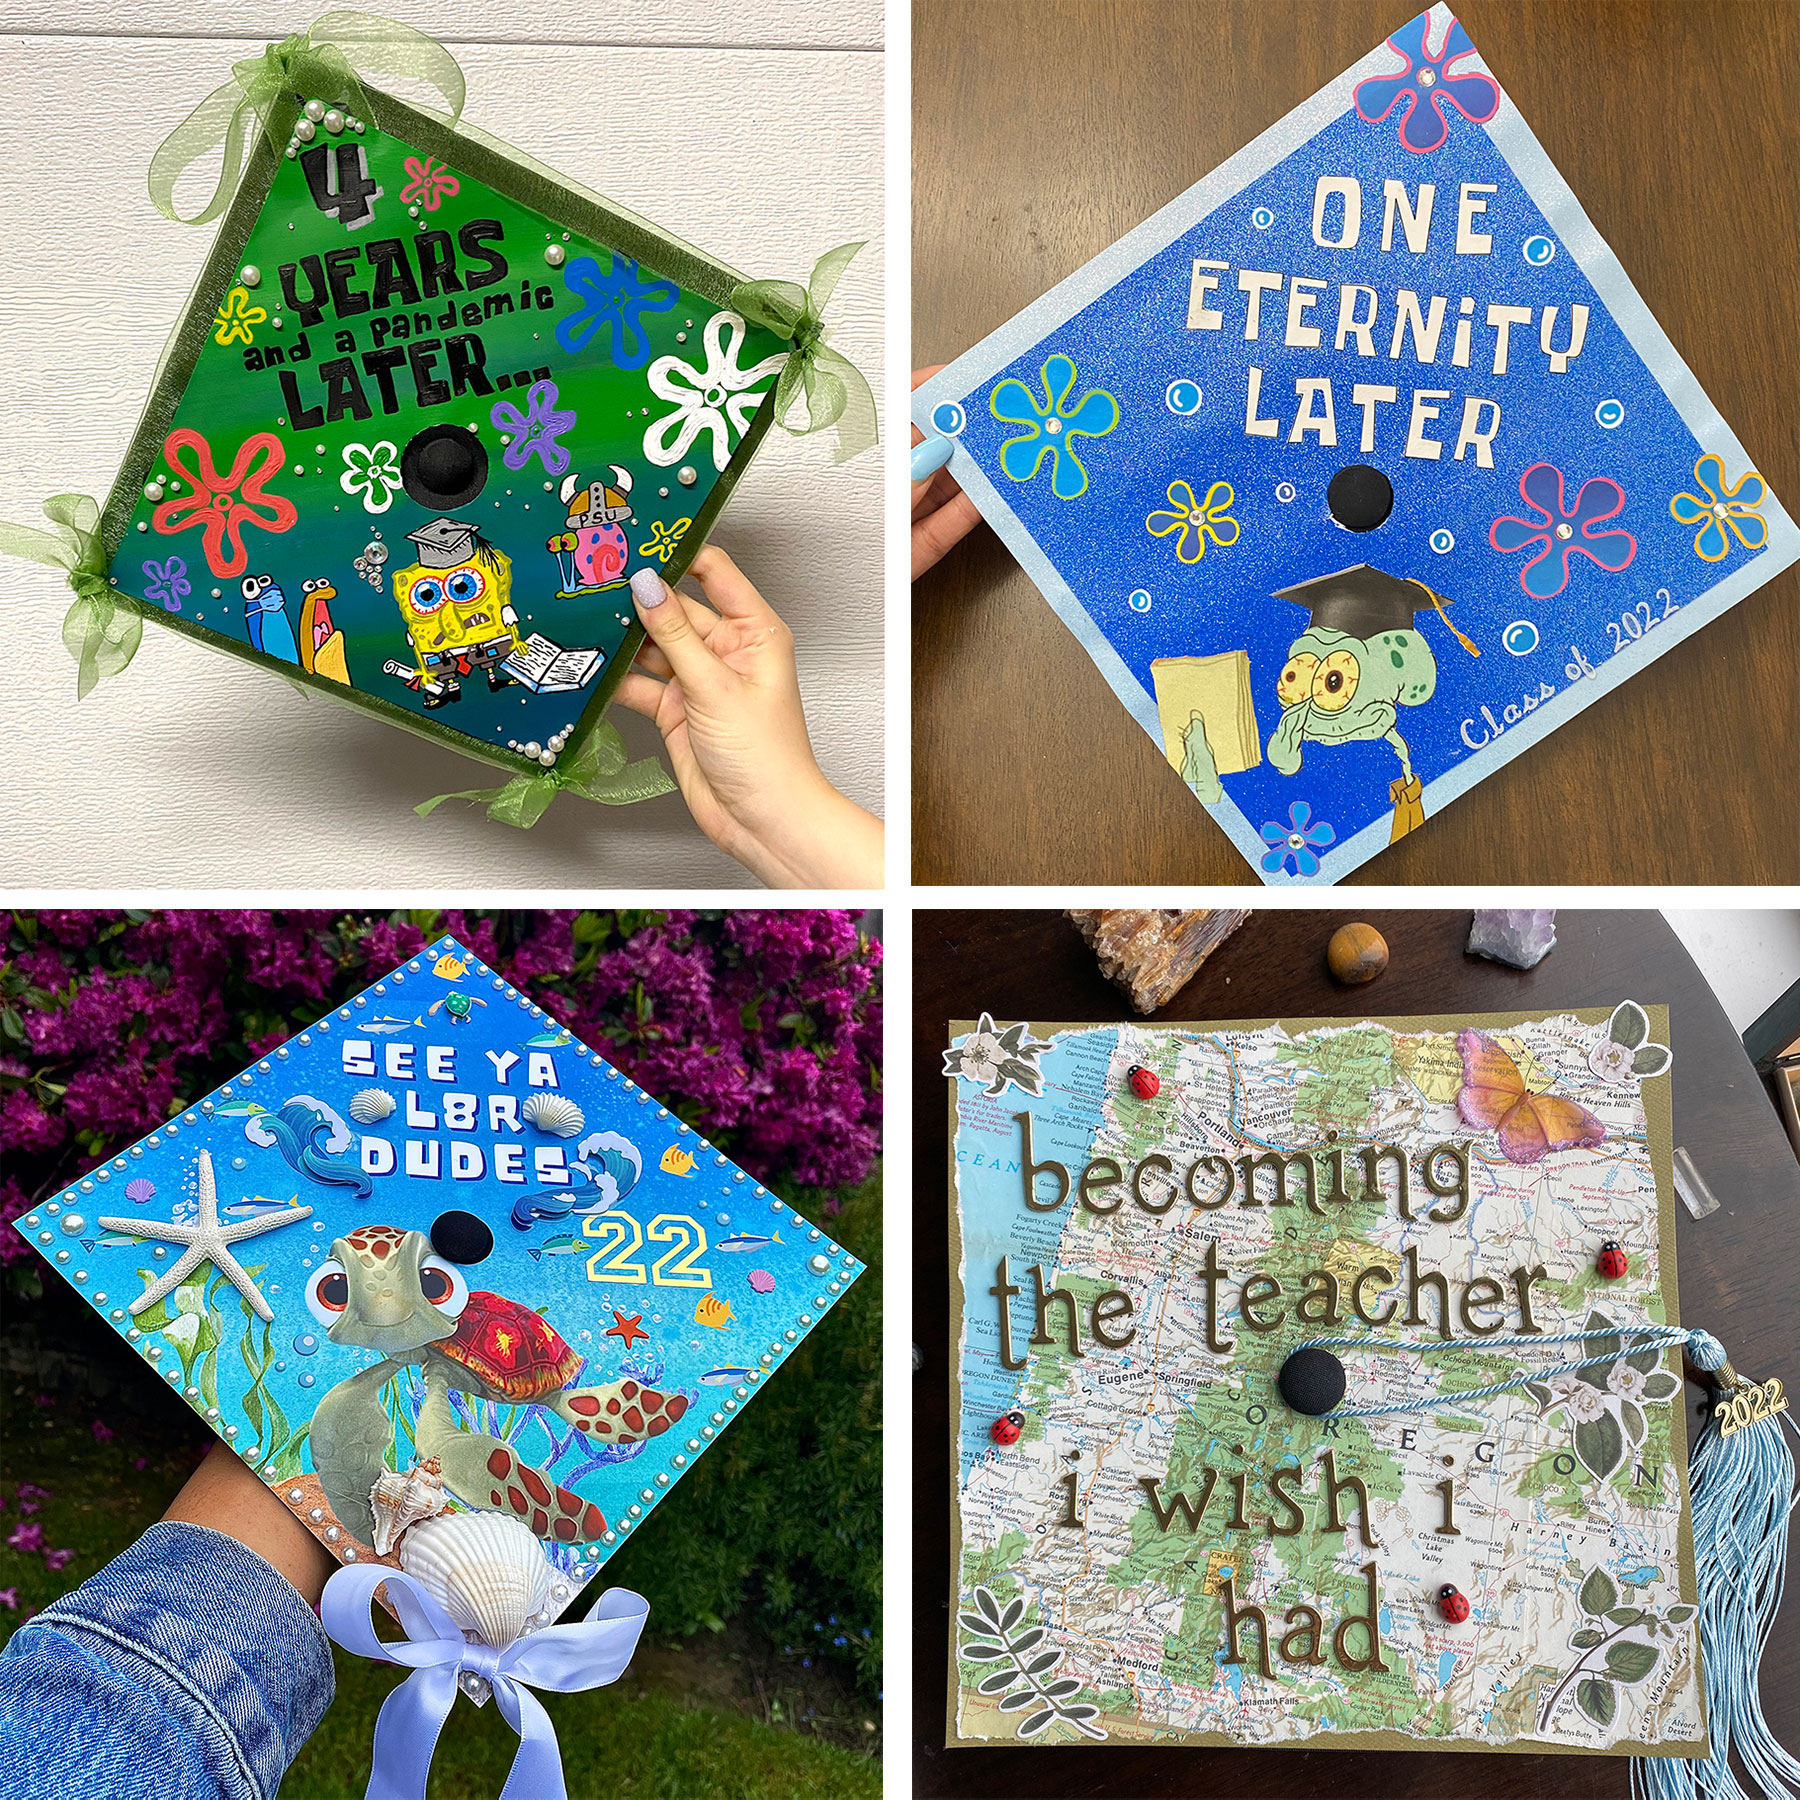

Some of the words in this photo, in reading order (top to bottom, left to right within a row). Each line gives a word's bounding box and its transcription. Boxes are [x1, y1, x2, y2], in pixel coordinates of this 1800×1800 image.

[299, 142, 384, 231] 4
[1312, 176, 1498, 255] ONE
[278, 219, 508, 328] YEARS
[243, 332, 312, 372] and
[335, 330, 356, 354] a
[370, 280, 554, 348] pandemic
[279, 334, 552, 431] LATER...
[1245, 367, 1501, 469] LATER
[579, 510, 617, 527] PSU
[1460, 682, 1555, 750] Class
[1565, 646, 1597, 680] of
[1606, 588, 1680, 653] 2022
[1235, 1042, 1257, 1052] Kelso
[1538, 1049, 1568, 1058] Granger
[342, 1040, 457, 1082] SEE
[485, 1049, 559, 1087] YA
[1417, 1055, 1445, 1067] Yakima
[1264, 1102, 1284, 1110] Battle
[1284, 1100, 1311, 1108] Ground
[1560, 1092, 1580, 1101] Horse
[1584, 1097, 1611, 1107] Heaven
[406, 1090, 526, 1134] L8R
[1239, 1109, 1292, 1127] Vancouver
[1034, 1115, 1051, 1124] Three
[1258, 1116, 1294, 1130] Orchards
[1166, 1127, 1189, 1138] Grove
[1181, 1113, 1208, 1140] Hillsboro
[1198, 1111, 1244, 1149] Portland
[1107, 1131, 1136, 1152] Tillamook
[1266, 1130, 1294, 1141] Camas
[1180, 1141, 1220, 1154] Beaverton
[361, 1136, 574, 1186] DUDES
[1591, 1150, 1627, 1166] Hermiston
[1012, 1111, 1474, 1224] becoming
[1569, 1184, 1596, 1192] Pendleton
[1016, 1214, 1042, 1225] Fogarty
[1043, 1219, 1064, 1228] Creek
[1214, 1213, 1235, 1222] Mount
[1236, 1215, 1256, 1225] Angel
[1011, 1223, 1025, 1231] Cape
[1213, 1222, 1243, 1231] Silverton
[1588, 1227, 1618, 1235] Heppner
[1009, 1232, 1035, 1242] Beverly
[1036, 1236, 1057, 1246] Beach
[1185, 1229, 1221, 1242] Salem
[582, 1211, 713, 1288] 22
[1020, 1249, 1054, 1260] Newport
[1337, 1262, 1359, 1272] Warm
[1101, 1271, 1144, 1285] Corvallis
[1154, 1270, 1181, 1282] Albany
[1586, 1291, 1627, 1302] NATIONAL
[990, 1254, 1138, 1371] the
[1199, 1239, 1547, 1354] teacher
[1534, 1315, 1561, 1323] Kimberly
[1443, 1356, 1471, 1365] Ochoco
[1474, 1359, 1514, 1370] Mountains
[1098, 1373, 1144, 1385] Eugene
[1159, 1371, 1212, 1389] Springfield
[1087, 1400, 1118, 1411] Cottage
[1119, 1405, 1143, 1415] Grove
[1715, 1377, 1789, 1438] 2022
[1109, 1429, 1128, 1438] Drain
[974, 1452, 991, 1462] Bay
[1020, 1455, 1040, 1465] Bend
[1000, 1460, 1030, 1470] Eastside
[1101, 1473, 1133, 1484] Sutherlin
[1403, 1468, 1434, 1479] Lavacicle
[994, 1487, 1023, 1498] Coquille
[1060, 1449, 1084, 1528] i
[1140, 1444, 1378, 1548] wish
[1434, 1454, 1461, 1535] i
[1021, 1510, 1035, 1518] Point
[1588, 1517, 1610, 1526] Burns
[1585, 1525, 1607, 1534] Hines
[1418, 1532, 1455, 1544] Christmas
[1511, 1522, 1587, 1545] Harney
[1609, 1538, 1671, 1556] Basin
[1426, 1544, 1443, 1552] Lake
[1422, 1554, 1444, 1564] Valley
[1043, 1621, 1063, 1630] Pass
[1219, 1561, 1390, 1681] had
[1117, 1657, 1158, 1672] Medford
[1489, 1650, 1522, 1694] Valley
[1650, 1646, 1689, 1703] Mountain
[1096, 1678, 1128, 1689] Ashland
[1244, 1698, 1277, 1706] Klamath
[1280, 1697, 1300, 1706] Falls
[1668, 1727, 1692, 1736] Desert
